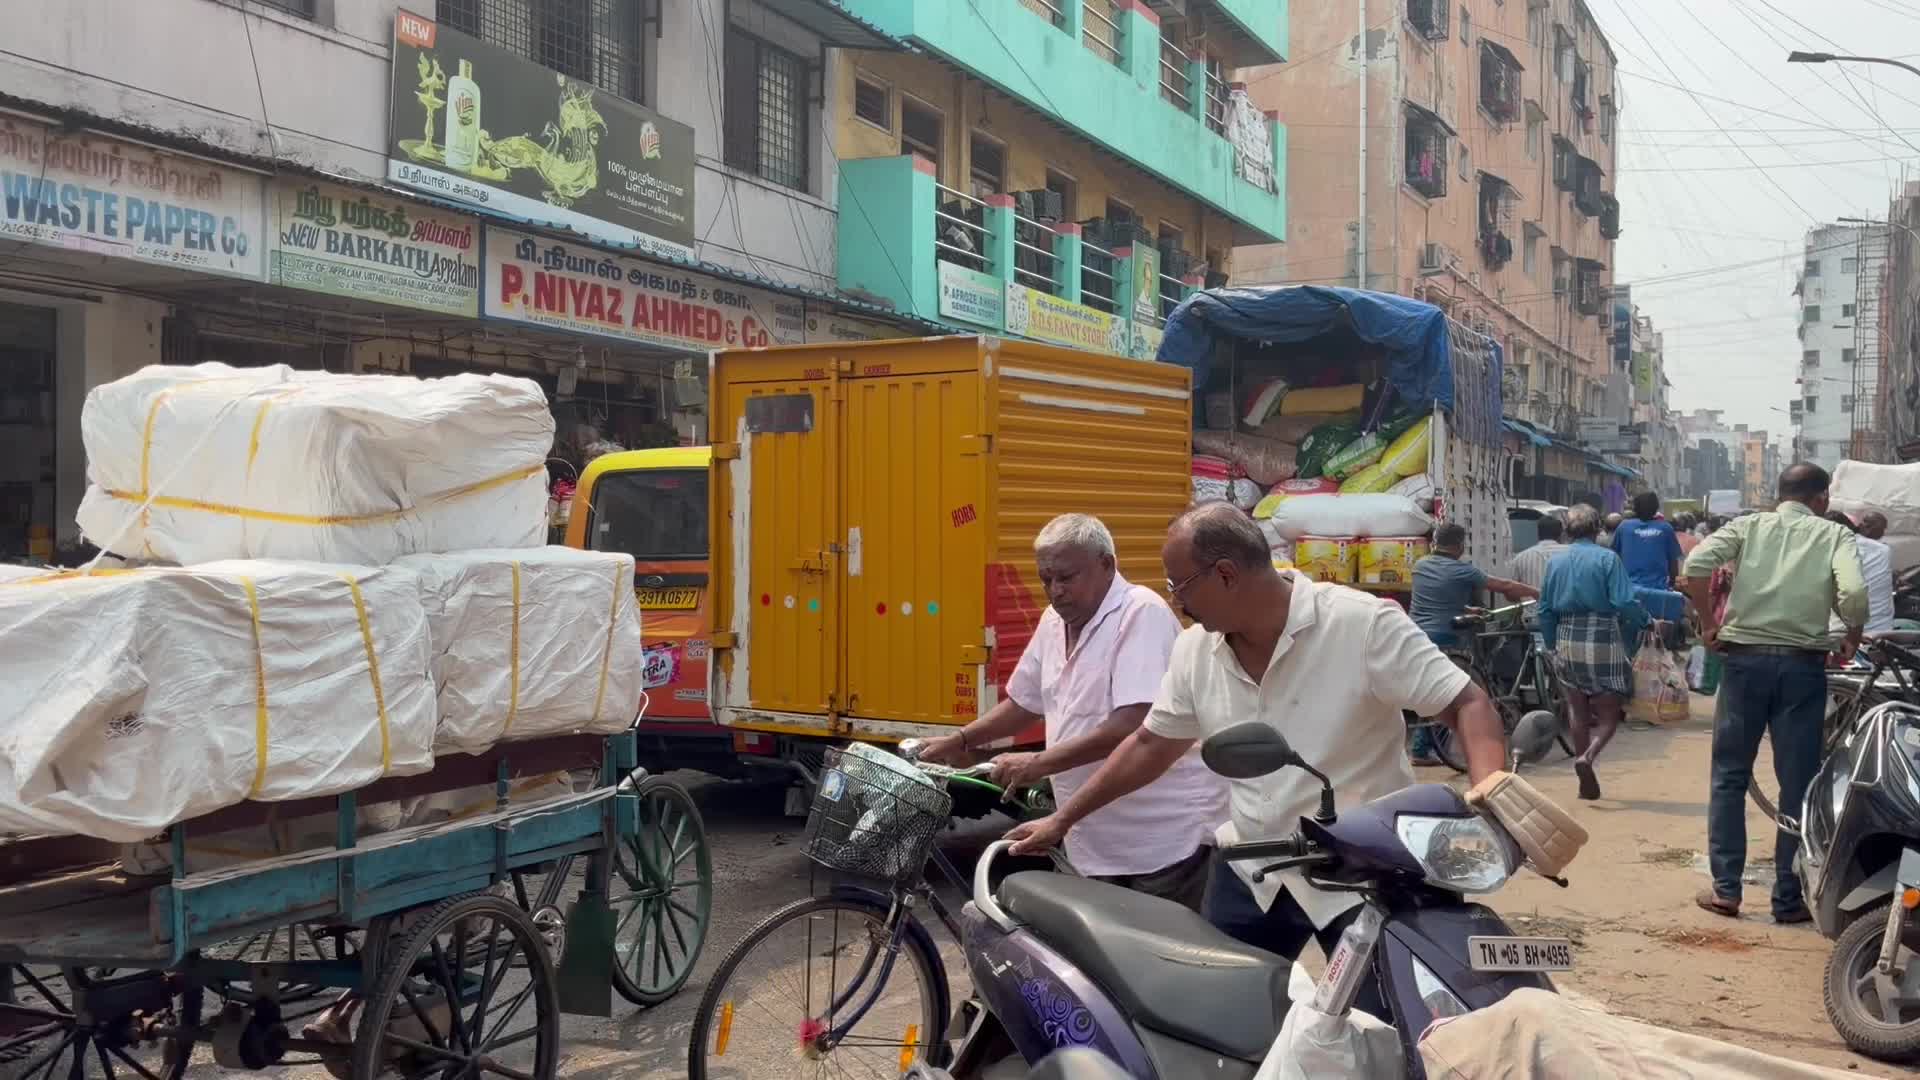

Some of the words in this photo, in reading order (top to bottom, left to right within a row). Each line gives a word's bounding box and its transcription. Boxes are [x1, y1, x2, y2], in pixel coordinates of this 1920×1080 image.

[401, 16, 430, 41] NEW
[607, 160, 627, 177] 100%
[2, 171, 118, 239] WASTE
[126, 196, 217, 252] PAPER
[410, 219, 471, 250] அப்பளம்
[280, 222, 320, 250] NEW
[325, 229, 433, 279] BARKATH
[431, 253, 477, 289] Appalam
[515, 238, 623, 281] பி.நியாஸ்
[632, 291, 722, 343] AHMED
[952, 503, 976, 528] HORN
[636, 589, 697, 606] 39TK0677
[1328, 946, 1347, 983] BOSCH
[1480, 943, 1497, 965] TN
[1524, 944, 1539, 966] BH
